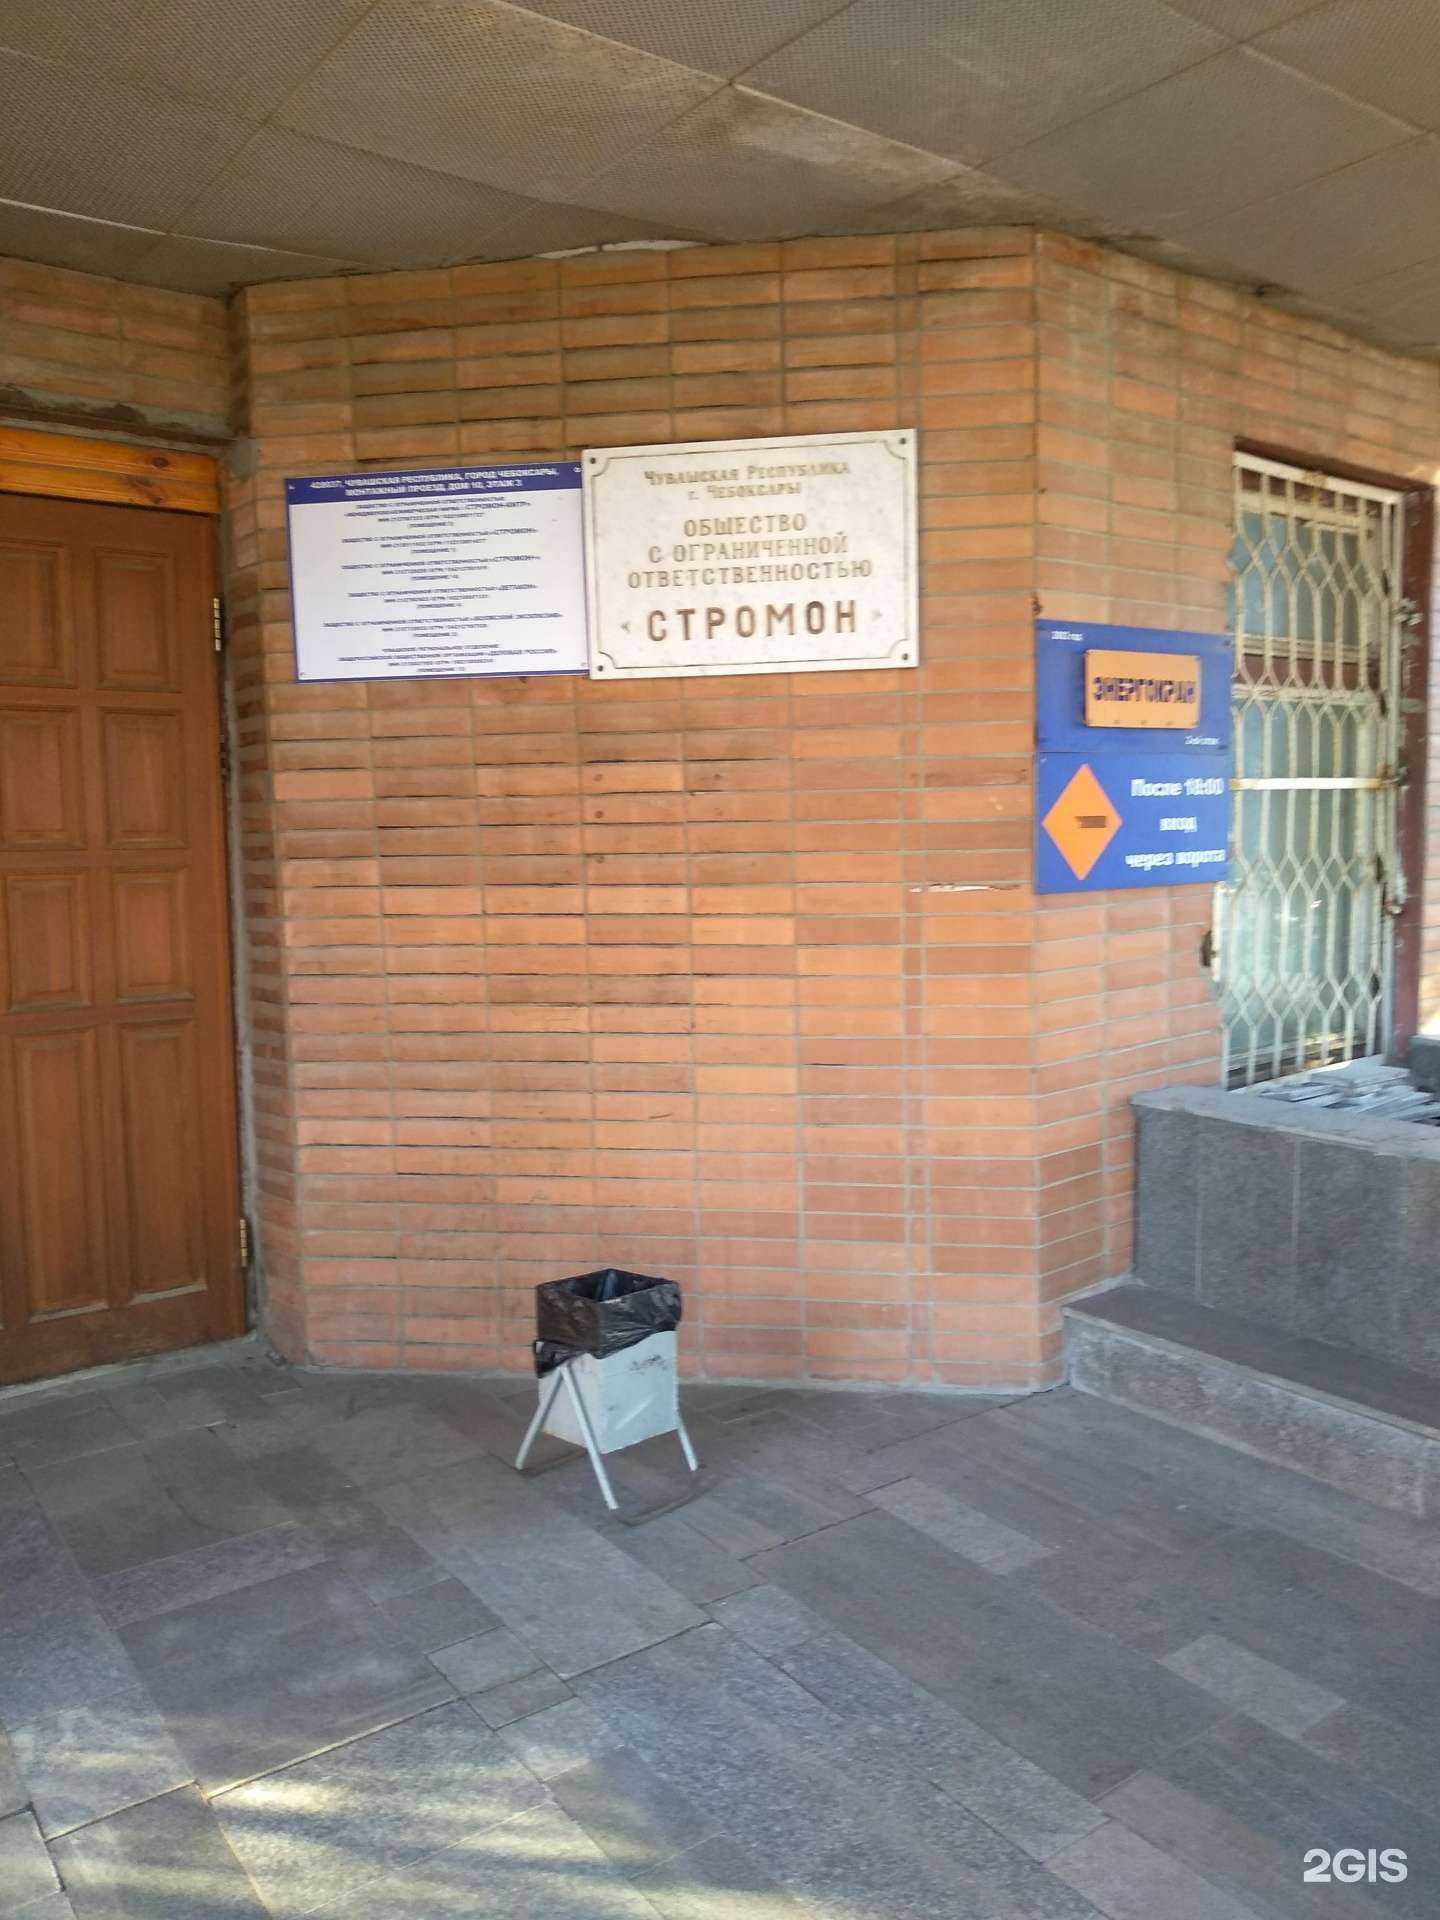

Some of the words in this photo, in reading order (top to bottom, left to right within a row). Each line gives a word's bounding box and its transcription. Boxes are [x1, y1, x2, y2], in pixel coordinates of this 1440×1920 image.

[683, 513, 807, 537] ОБЩЕСТВО
[648, 545, 665, 564] С
[673, 531, 849, 563] ОГРАНИЧЕННОЙ
[627, 559, 873, 589] ОТВЕТСТВЕННОСТЬЮ
[1130, 777, 1183, 797] После
[1125, 852, 1175, 871] через
